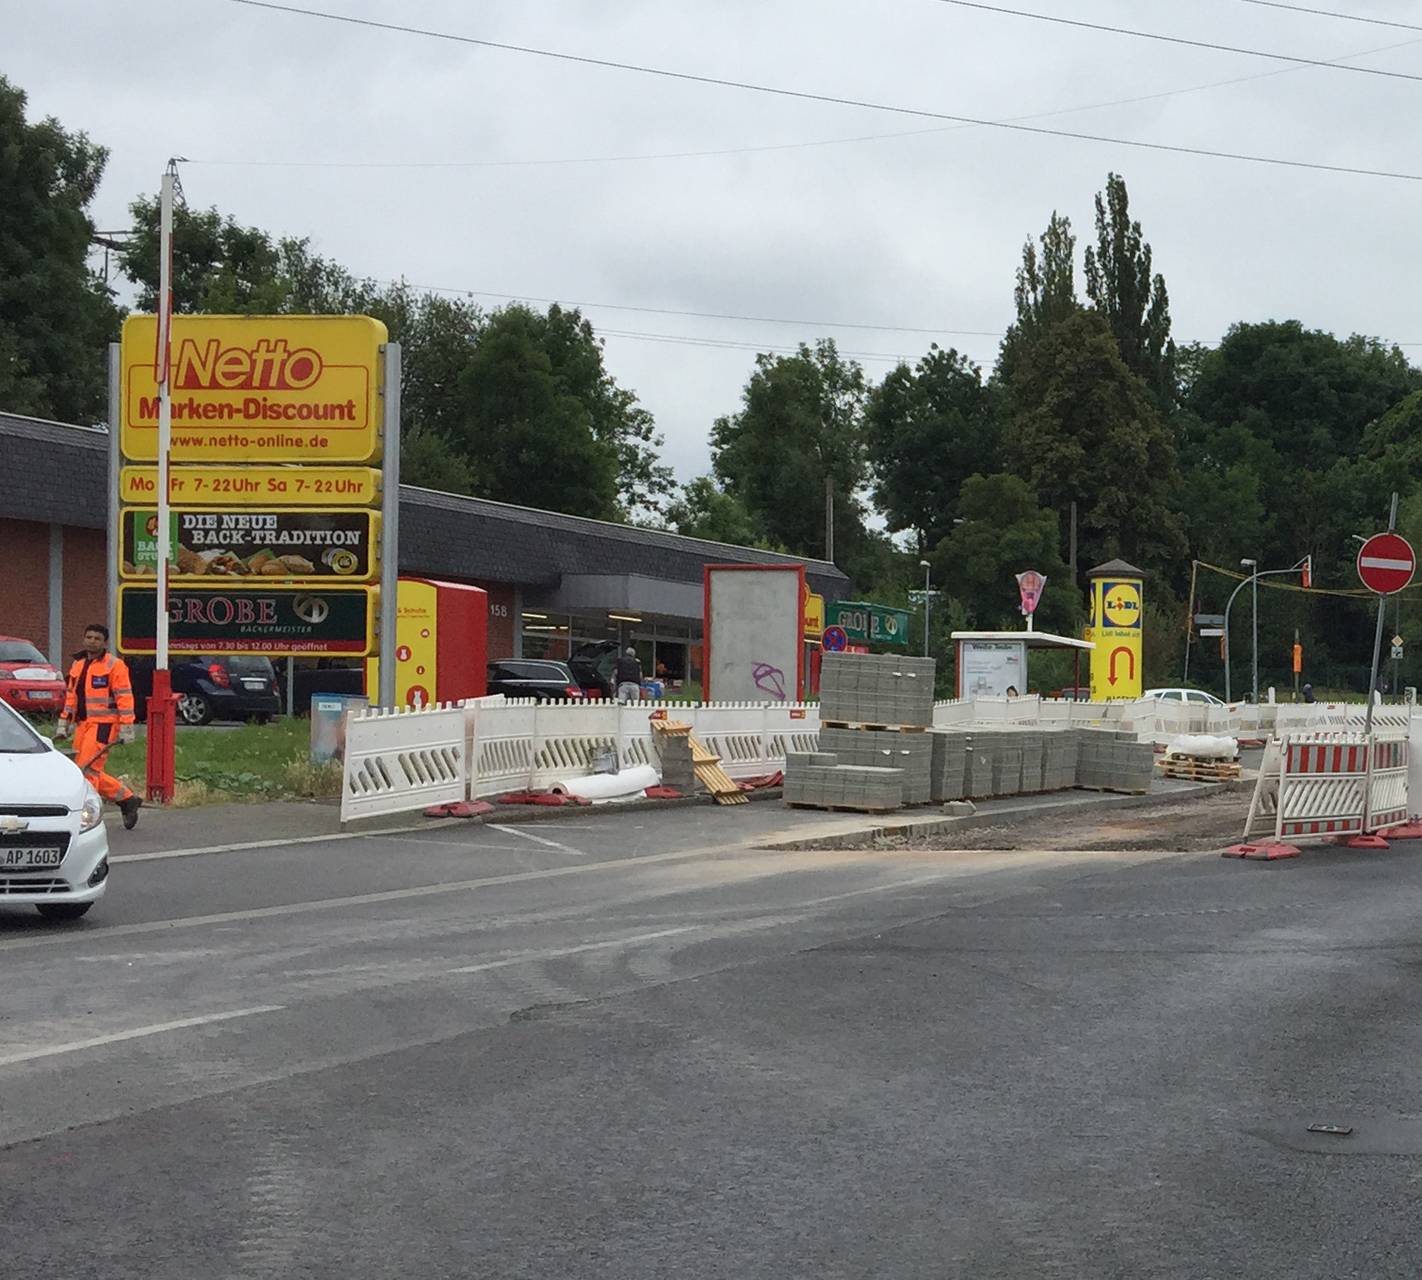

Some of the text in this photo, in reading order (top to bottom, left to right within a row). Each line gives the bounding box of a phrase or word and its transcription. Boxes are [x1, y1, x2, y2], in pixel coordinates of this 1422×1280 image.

[175, 338, 322, 389] Netto
[130, 477, 154, 491] Mo
[171, 478, 185, 491] Fr
[268, 477, 287, 492] Sa
[183, 514, 277, 529] DIE NEUE
[192, 530, 361, 546] BACK-TRADITION
[491, 604, 508, 617] 158
[6, 850, 58, 865] AP 1603
